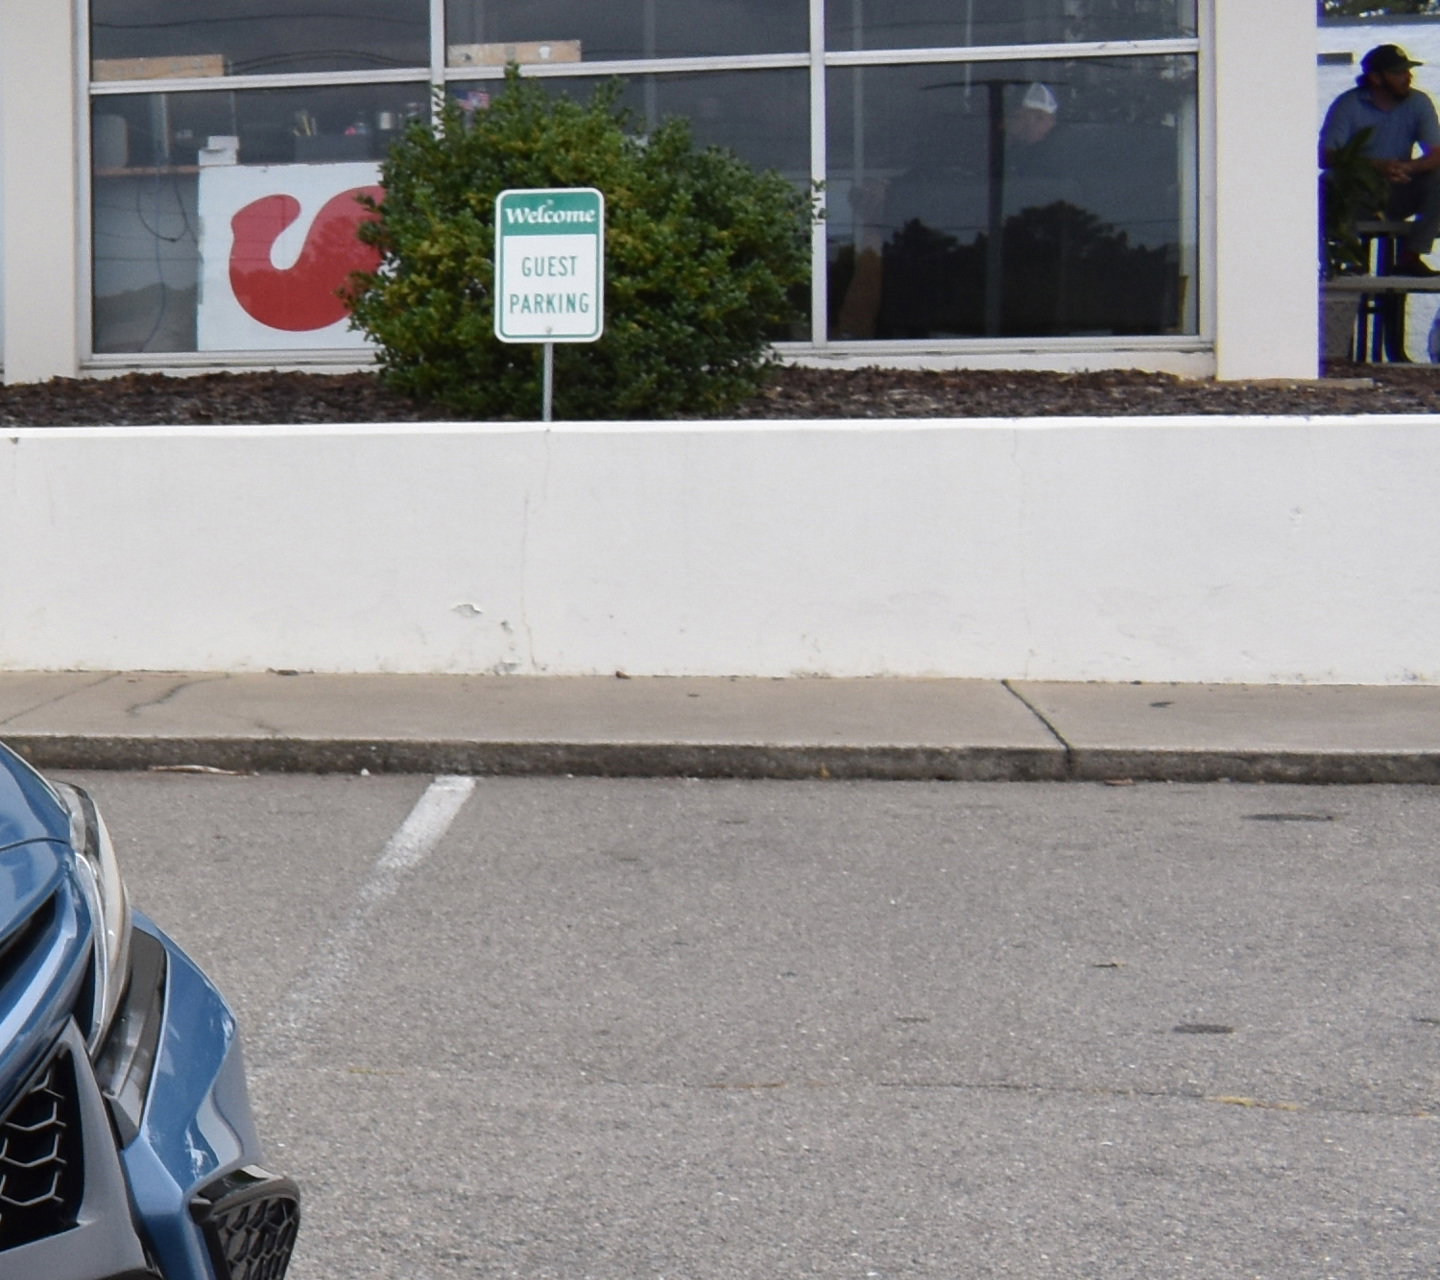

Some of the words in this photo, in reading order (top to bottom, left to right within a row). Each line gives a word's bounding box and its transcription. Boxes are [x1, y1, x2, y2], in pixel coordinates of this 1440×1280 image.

[505, 204, 597, 224] Welcome
[521, 255, 578, 278] GUEST
[509, 292, 590, 315] PARKING
